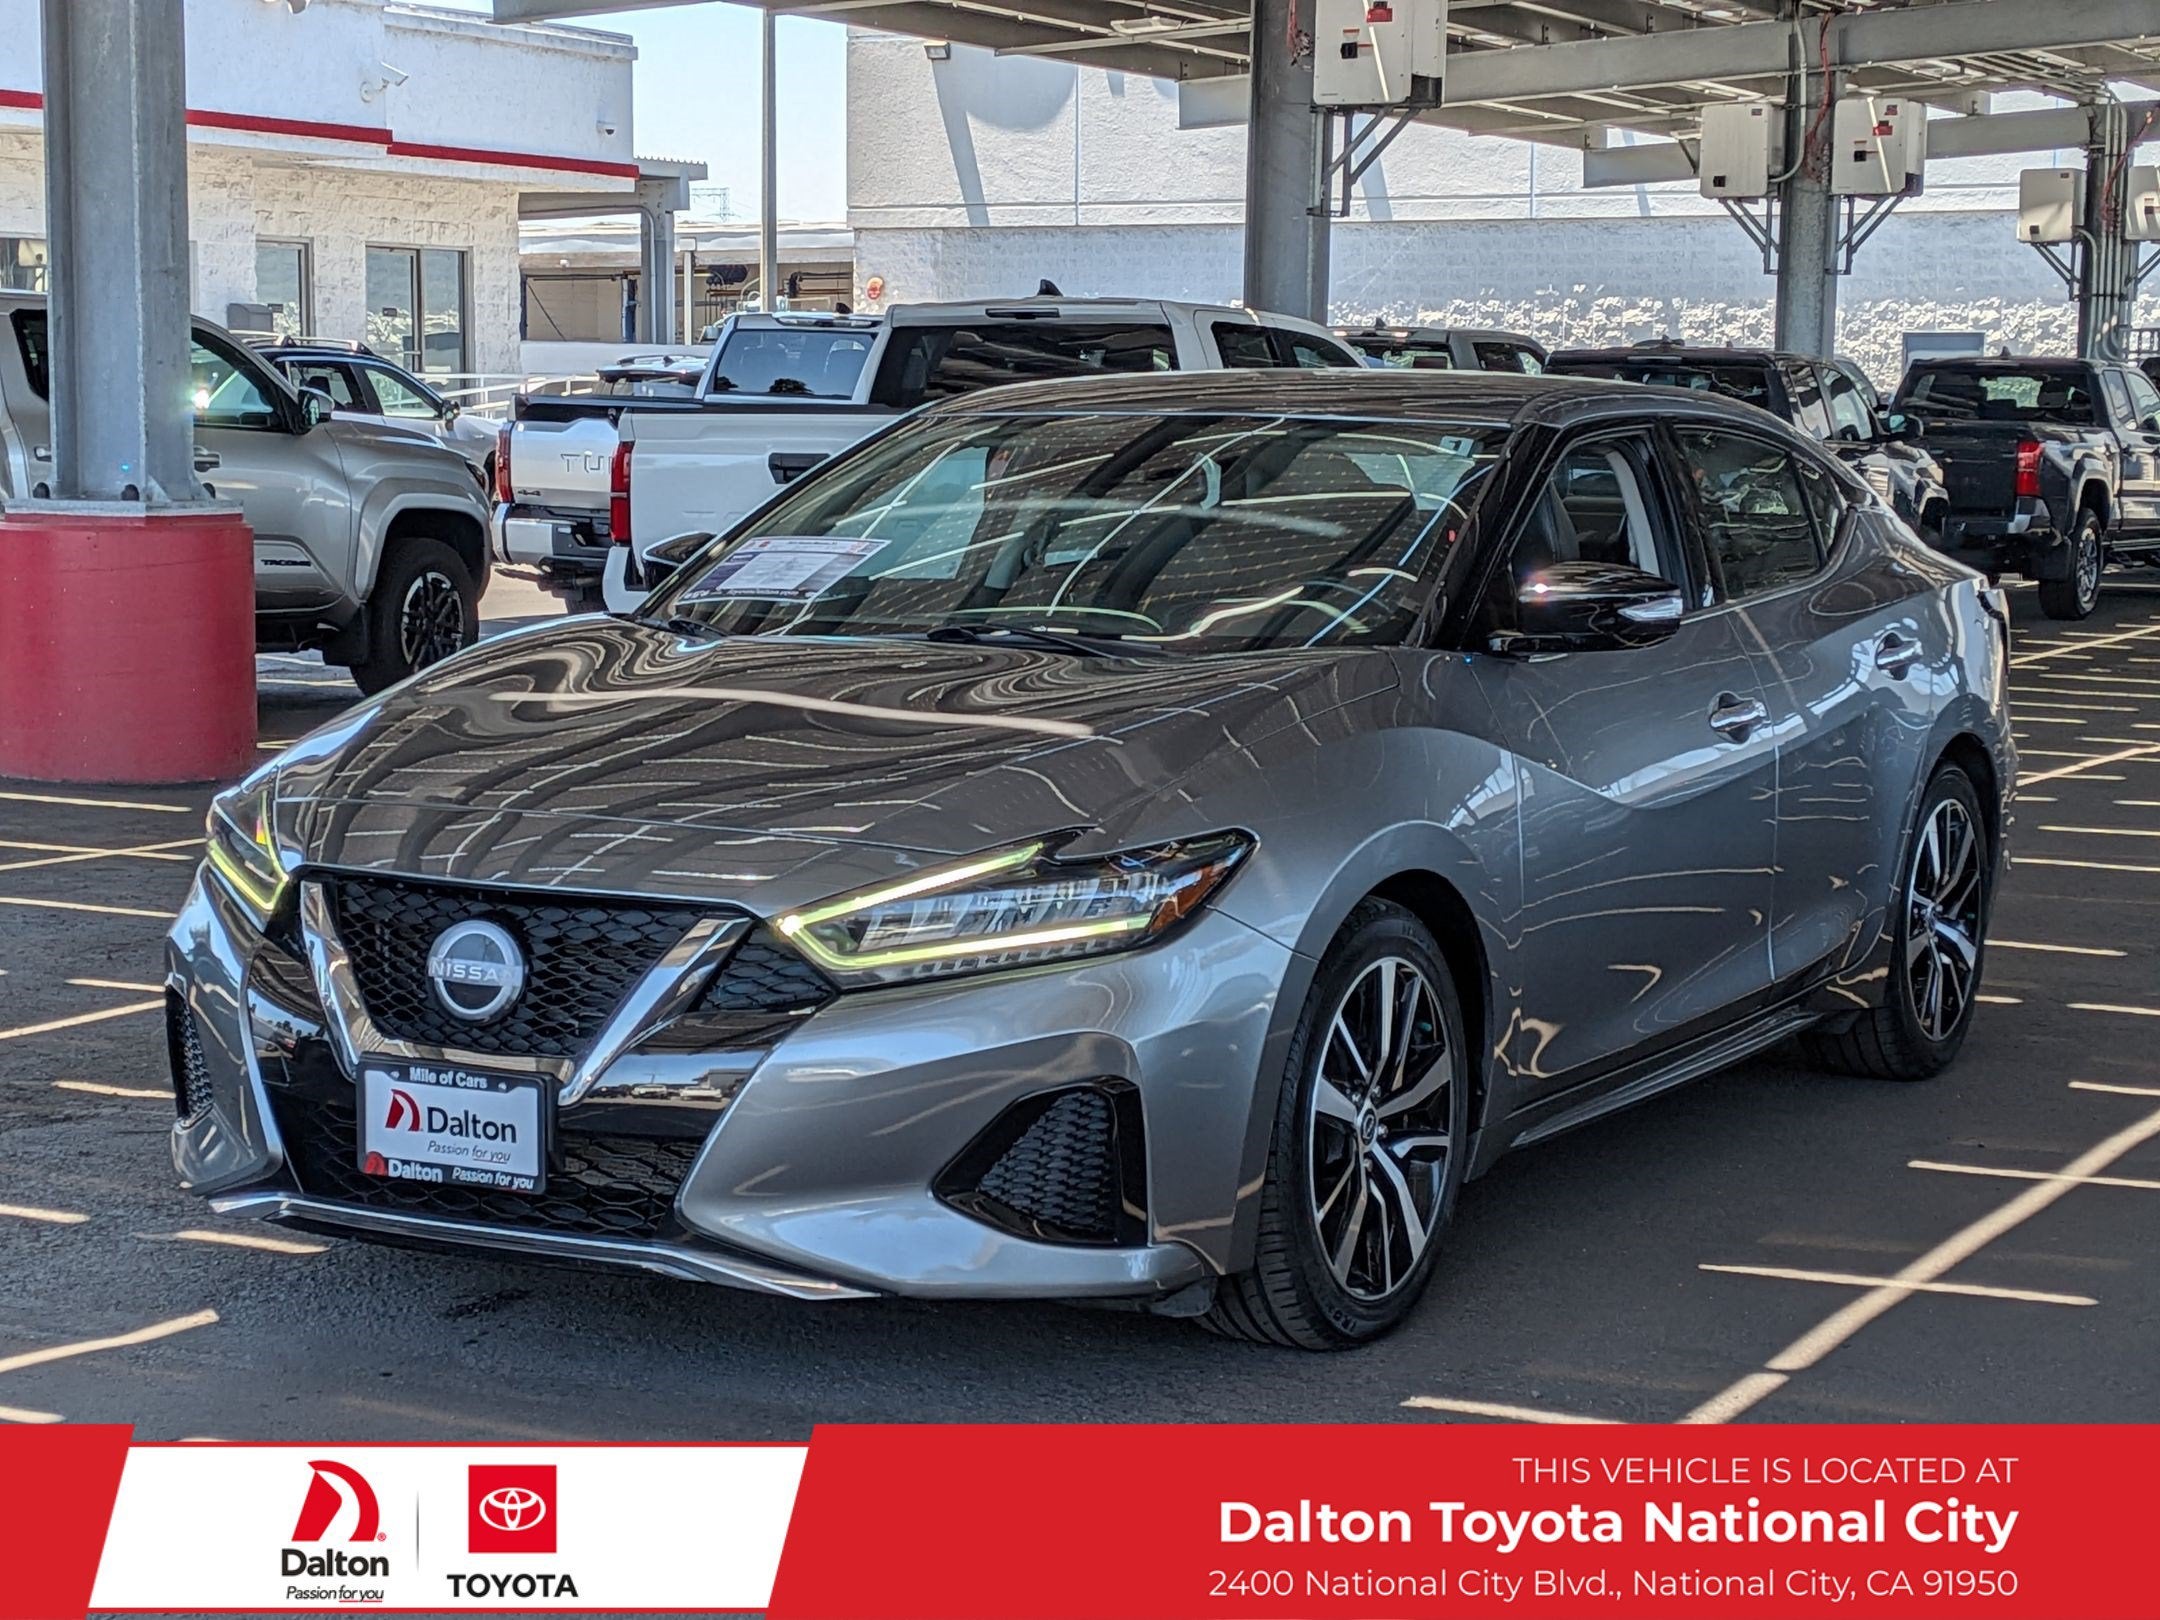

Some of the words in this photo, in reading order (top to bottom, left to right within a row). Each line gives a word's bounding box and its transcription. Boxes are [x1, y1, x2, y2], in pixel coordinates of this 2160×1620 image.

[560, 452, 612, 474] TU
[409, 1066, 437, 1084] Mile
[439, 1070, 454, 1086] of
[455, 1072, 488, 1089] Cars
[427, 1106, 517, 1143] Dalton
[427, 1140, 469, 1156] Passion
[472, 1145, 487, 1159] for
[489, 1151, 511, 1163] you
[387, 1159, 443, 1183] Dalton
[451, 1166, 494, 1185] Passion
[494, 1172, 512, 1187] for
[512, 1175, 535, 1190] you
